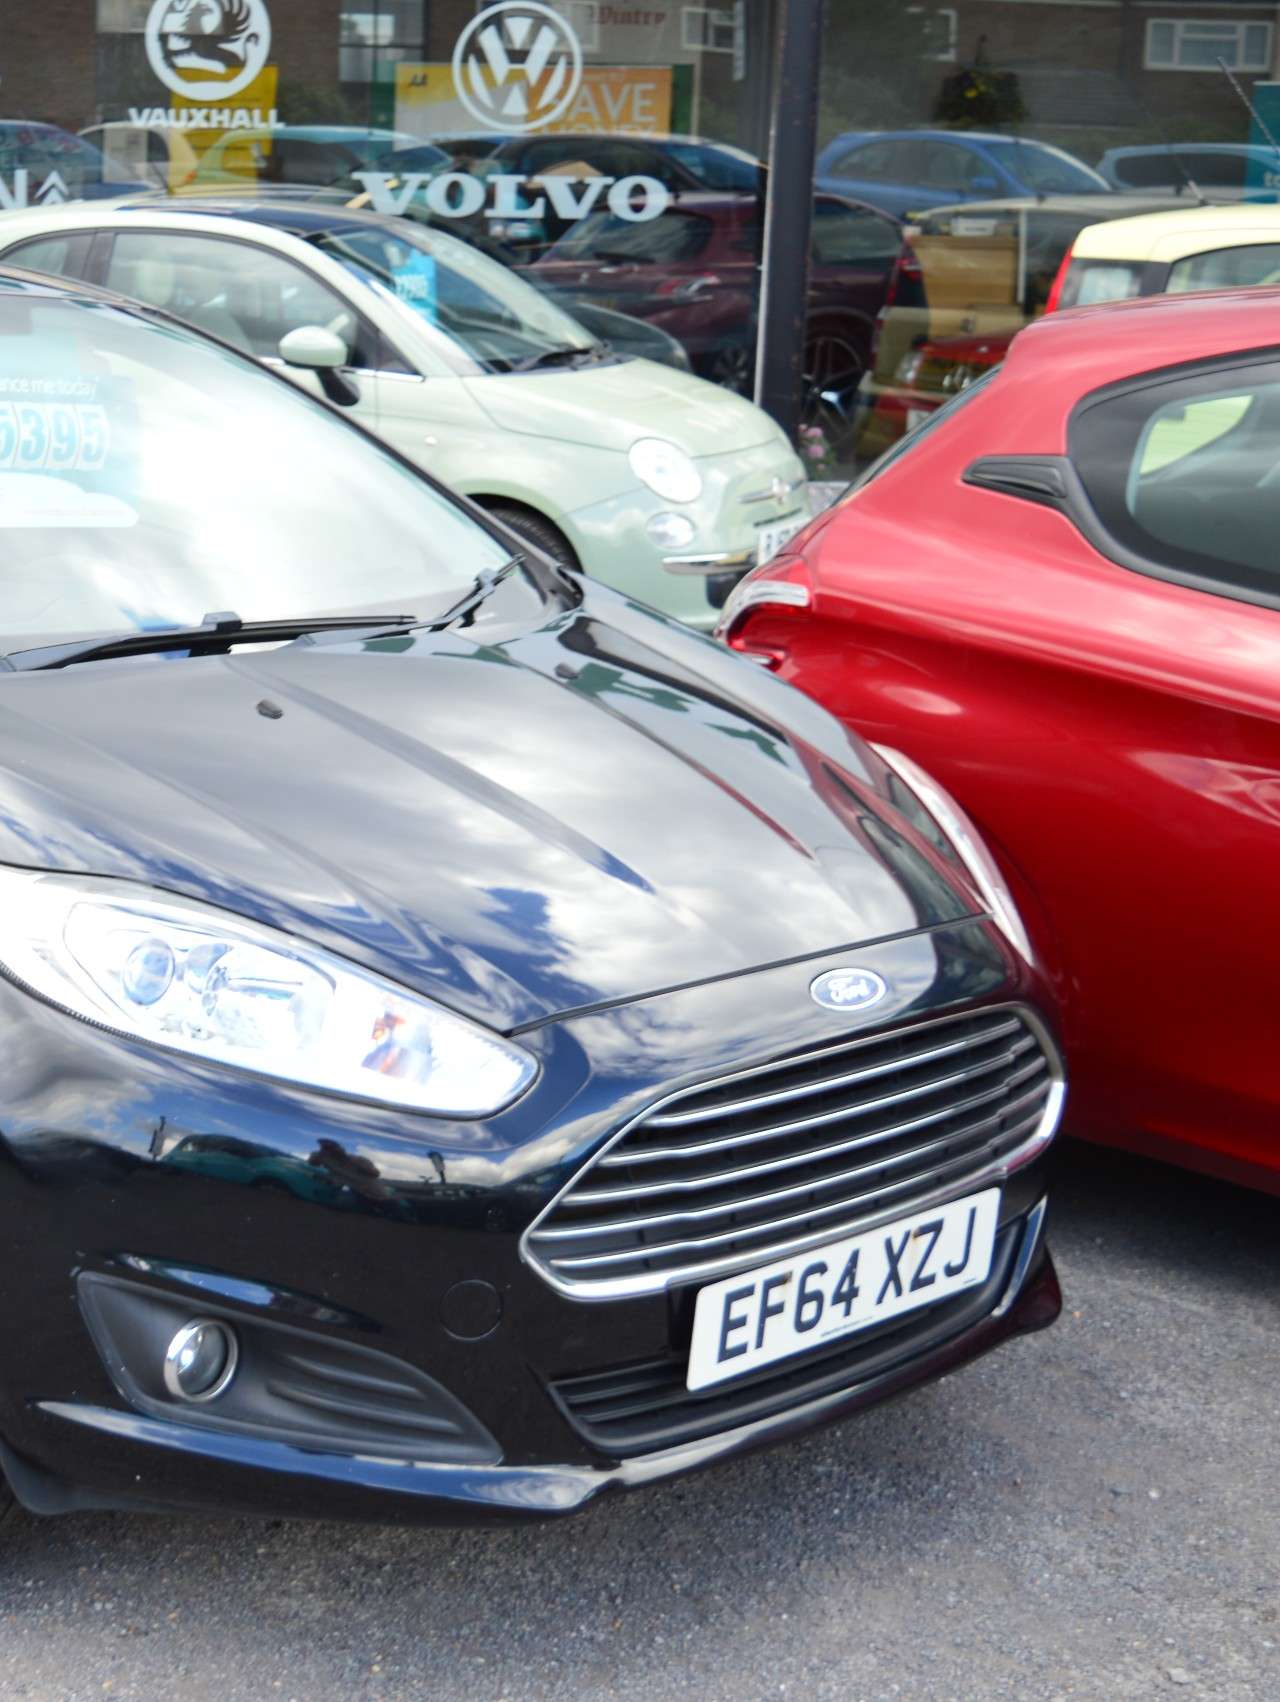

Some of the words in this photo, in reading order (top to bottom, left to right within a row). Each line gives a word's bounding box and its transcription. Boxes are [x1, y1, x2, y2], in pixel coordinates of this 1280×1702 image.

[128, 107, 286, 128] VAUXHALL
[554, 82, 657, 123] AVE
[352, 172, 669, 222] VOLVO
[717, 1248, 860, 1364] EF64
[875, 1206, 977, 1305] XZJ
